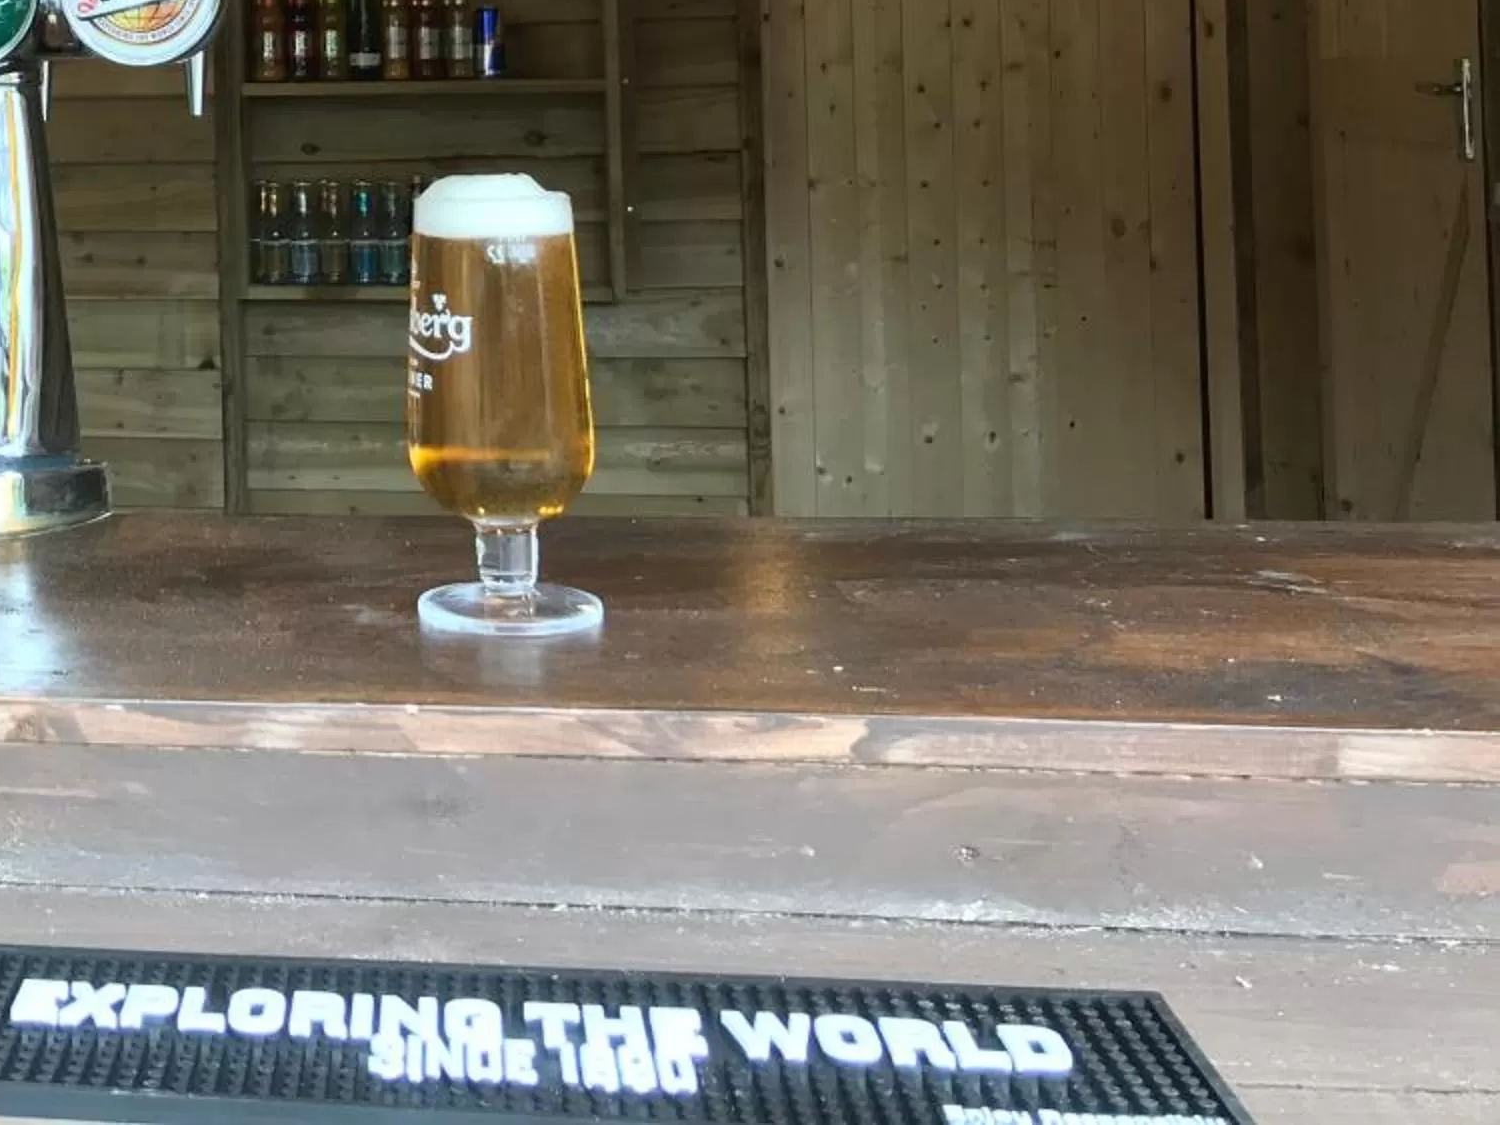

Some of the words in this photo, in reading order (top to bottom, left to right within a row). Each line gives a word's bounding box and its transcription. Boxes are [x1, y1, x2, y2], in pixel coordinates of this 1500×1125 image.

[9, 978, 503, 1051] EXPLORING
[523, 1001, 707, 1063] THE
[719, 1009, 1074, 1075] WORLD
